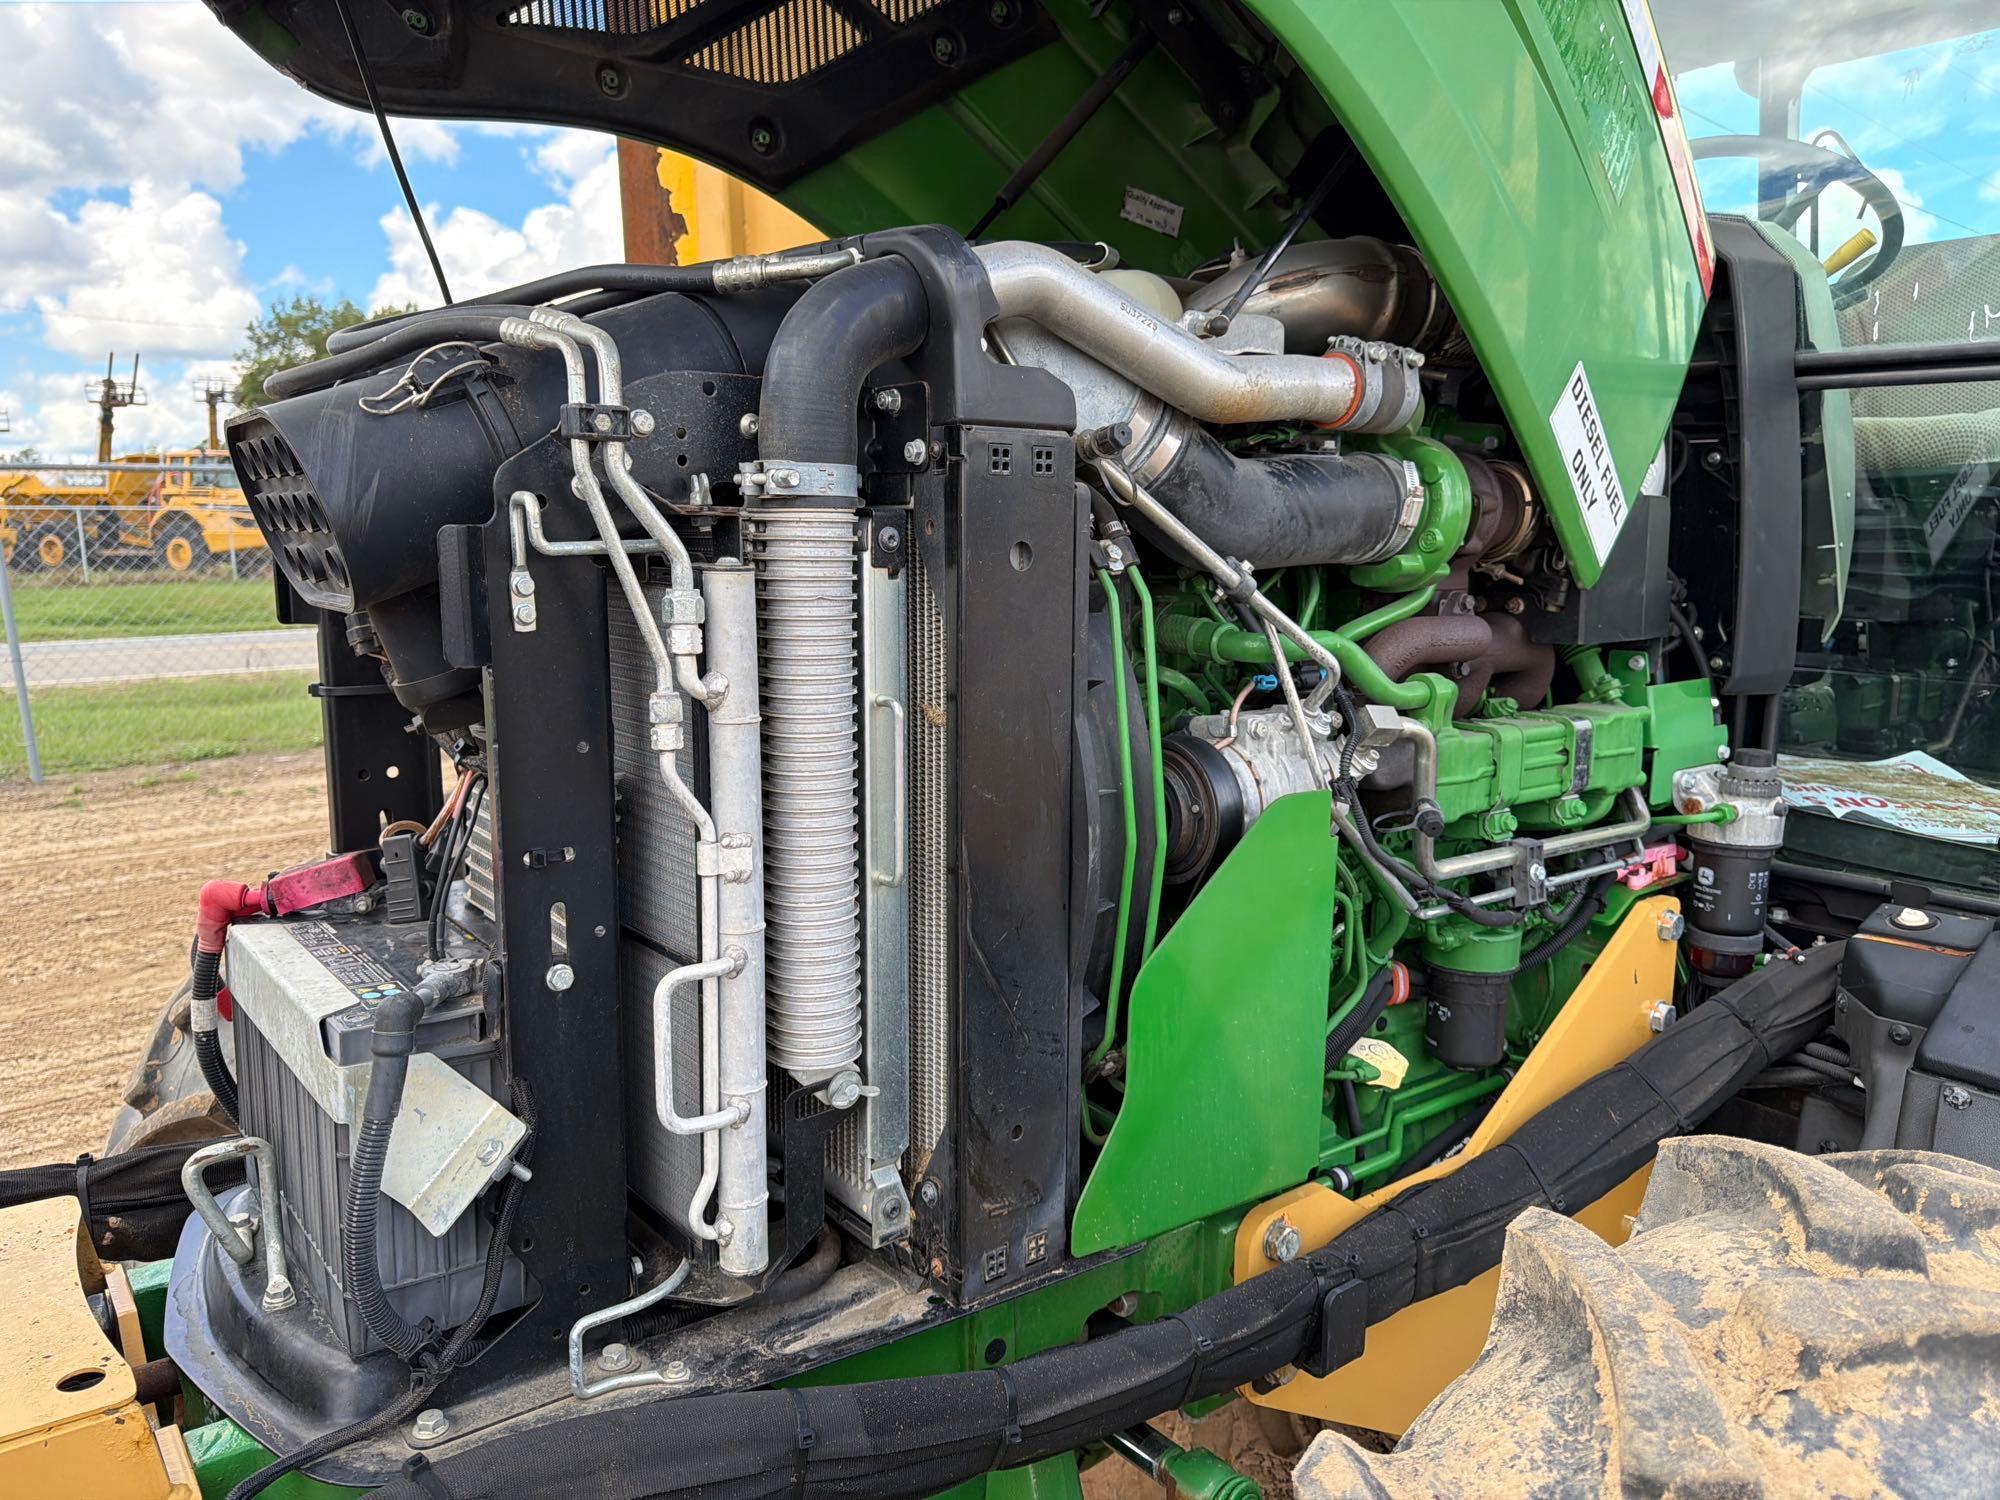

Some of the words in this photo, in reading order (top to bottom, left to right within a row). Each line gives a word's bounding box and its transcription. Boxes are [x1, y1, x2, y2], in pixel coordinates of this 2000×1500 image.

[1571, 376, 1605, 470] DIESEL
[1600, 463, 1622, 526] FUEL
[1572, 448, 1598, 511] ONLY
